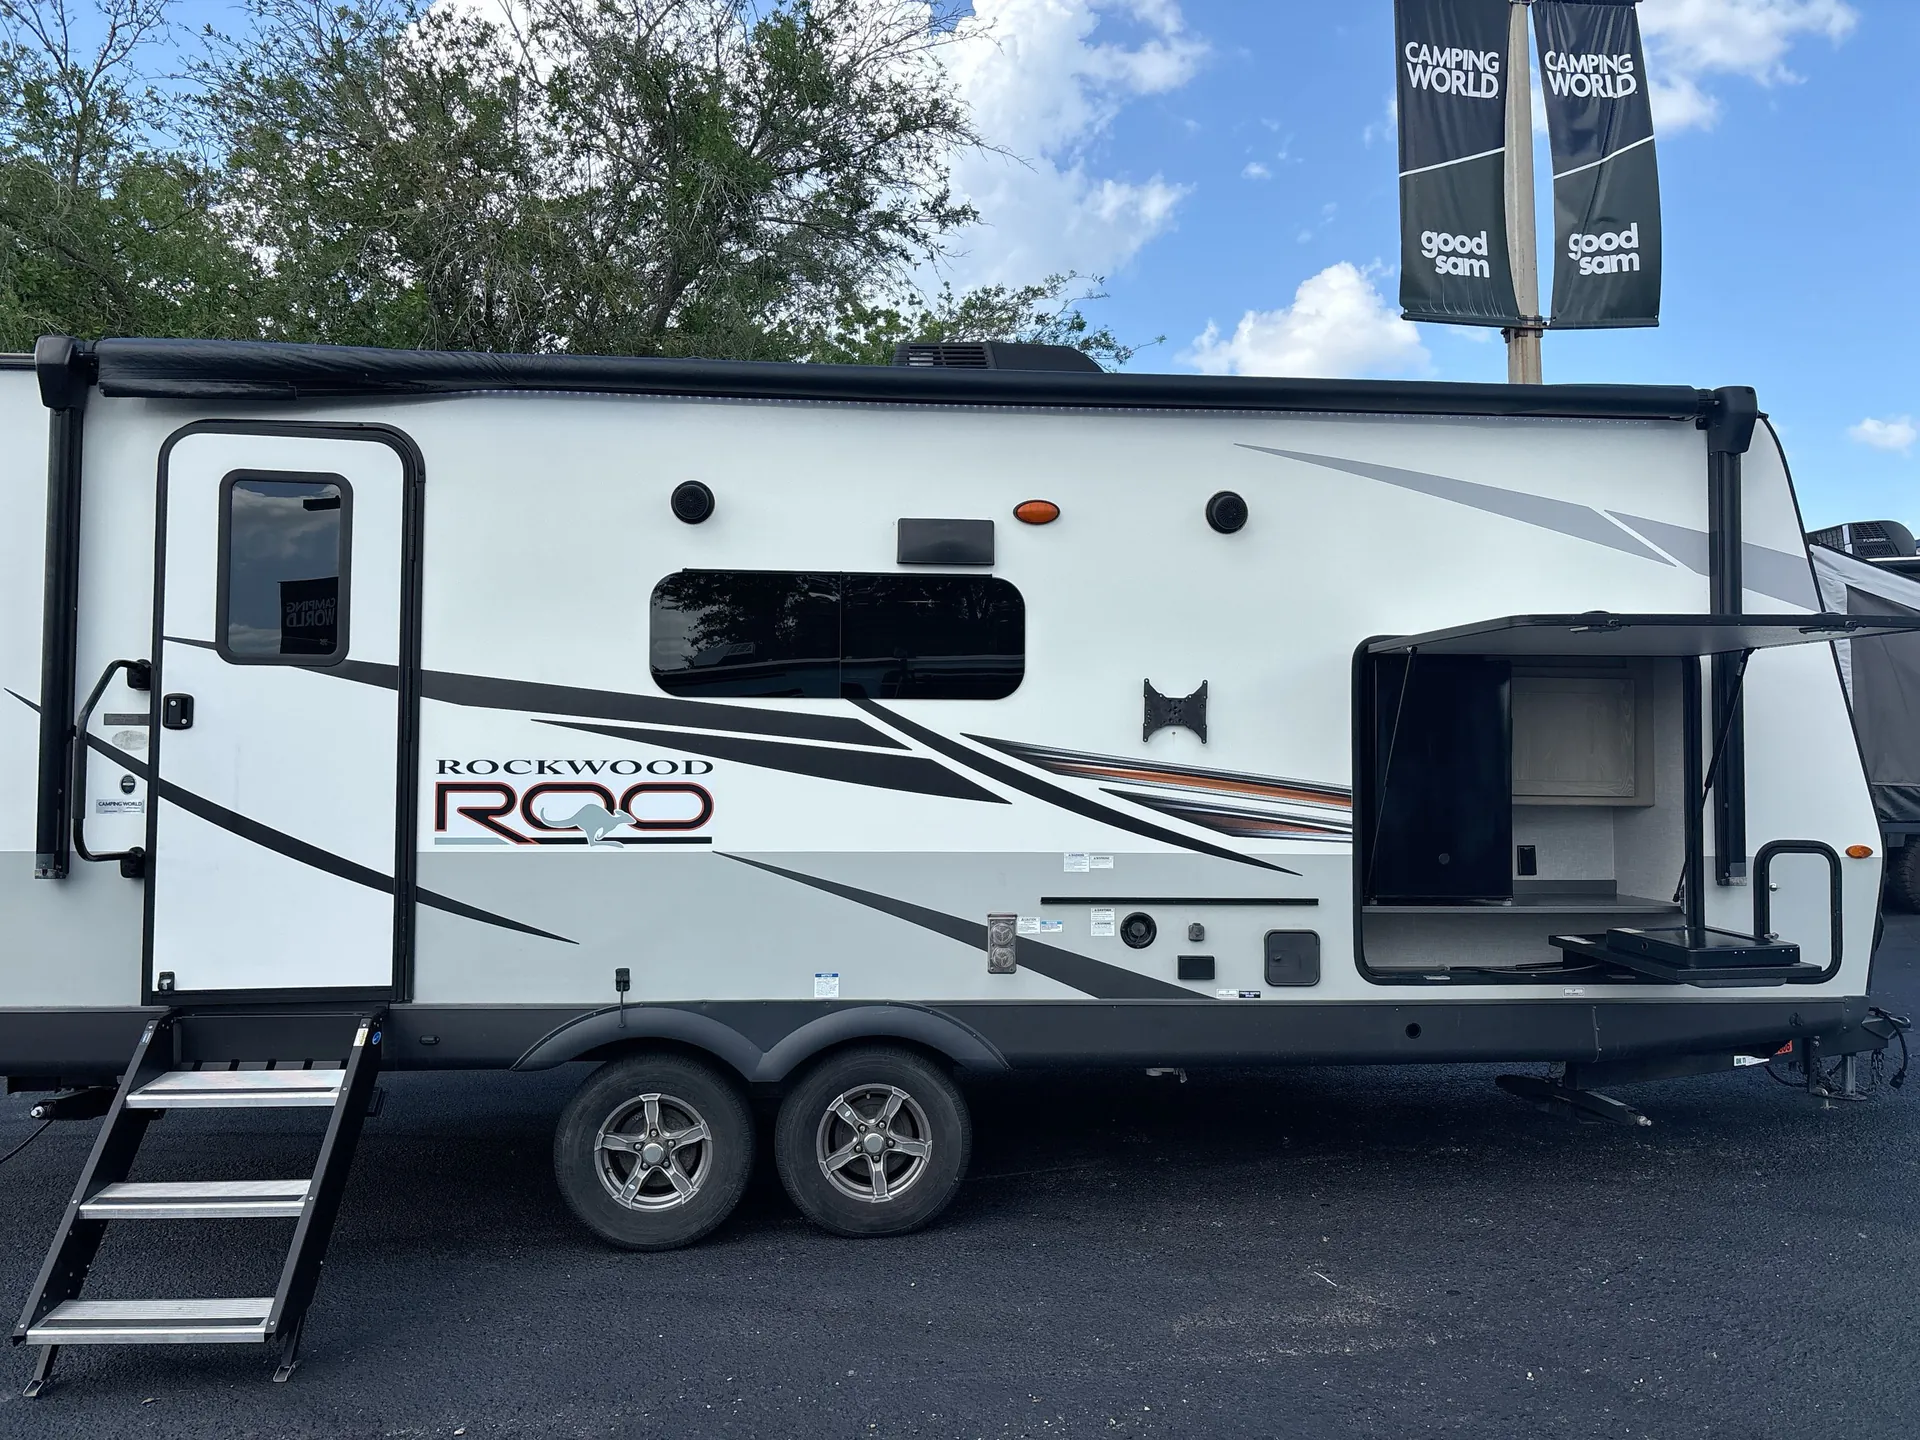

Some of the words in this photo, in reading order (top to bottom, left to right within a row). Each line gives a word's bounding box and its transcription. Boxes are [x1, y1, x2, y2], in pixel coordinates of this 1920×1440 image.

[1405, 41, 1499, 73] CAMPING
[1544, 50, 1634, 73] CAMPING
[1406, 62, 1499, 99] WORLD
[1547, 71, 1638, 98] WORLD
[1421, 230, 1488, 259] good
[1568, 222, 1639, 260] good
[1435, 254, 1490, 278] sam
[1579, 251, 1640, 275] sam
[436, 759, 714, 775] ROCKWOOD
[434, 781, 715, 845] ROO
